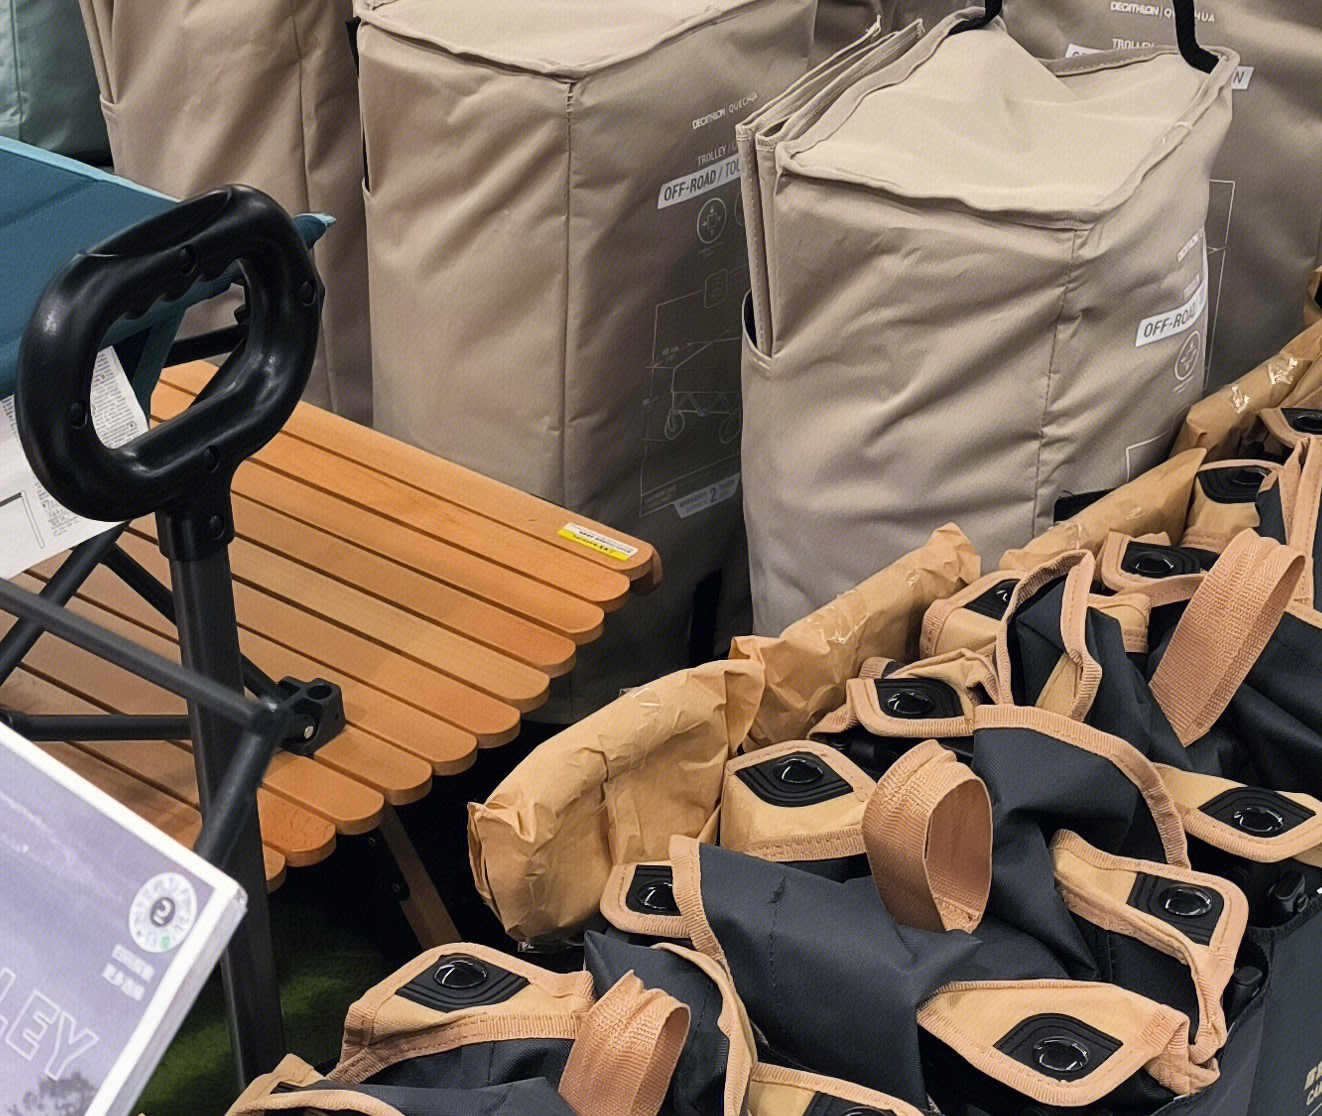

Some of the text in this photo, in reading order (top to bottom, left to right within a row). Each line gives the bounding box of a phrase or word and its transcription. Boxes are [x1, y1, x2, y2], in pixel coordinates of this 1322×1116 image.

[1110, 1, 1159, 17] DECATHLON
[697, 145, 727, 167] TROLLEY
[664, 170, 717, 202] OFF-ROAD
[1143, 301, 1196, 338] OFF-ROAD
